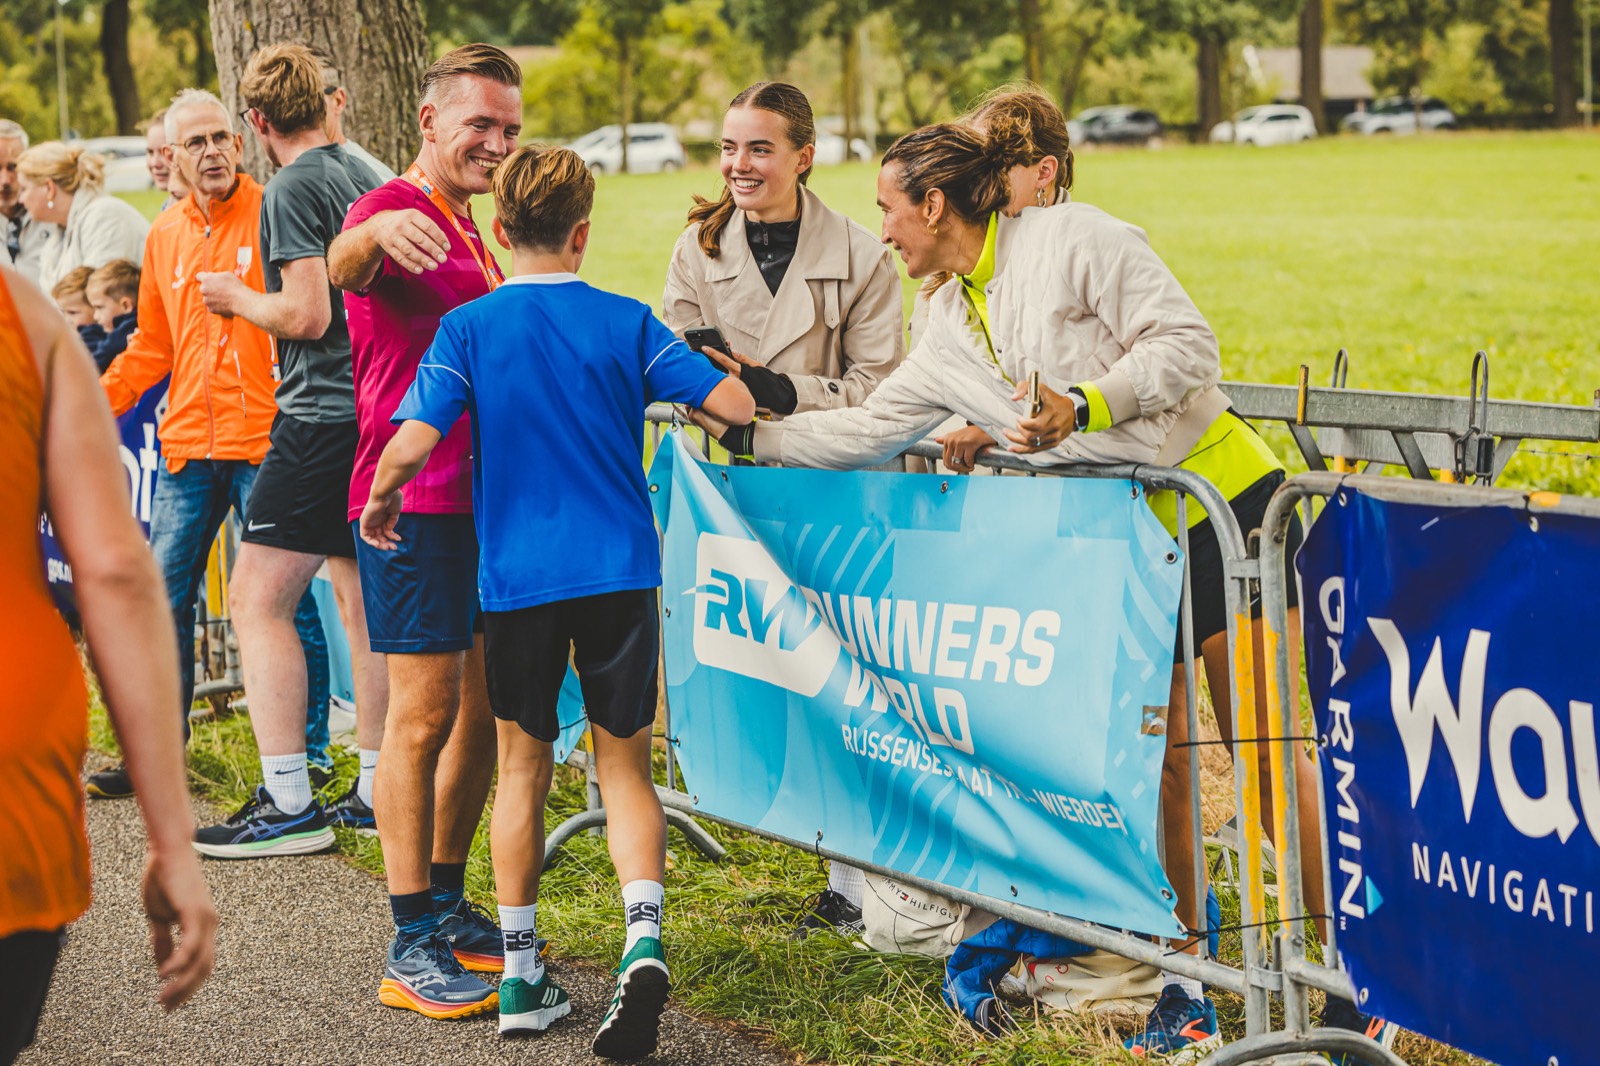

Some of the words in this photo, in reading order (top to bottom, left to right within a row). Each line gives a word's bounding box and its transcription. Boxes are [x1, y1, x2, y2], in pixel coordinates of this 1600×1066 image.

[704, 567, 823, 652] RW
[1319, 575, 1366, 920] GARMIN
[1411, 841, 1595, 934] NAVIGATI
